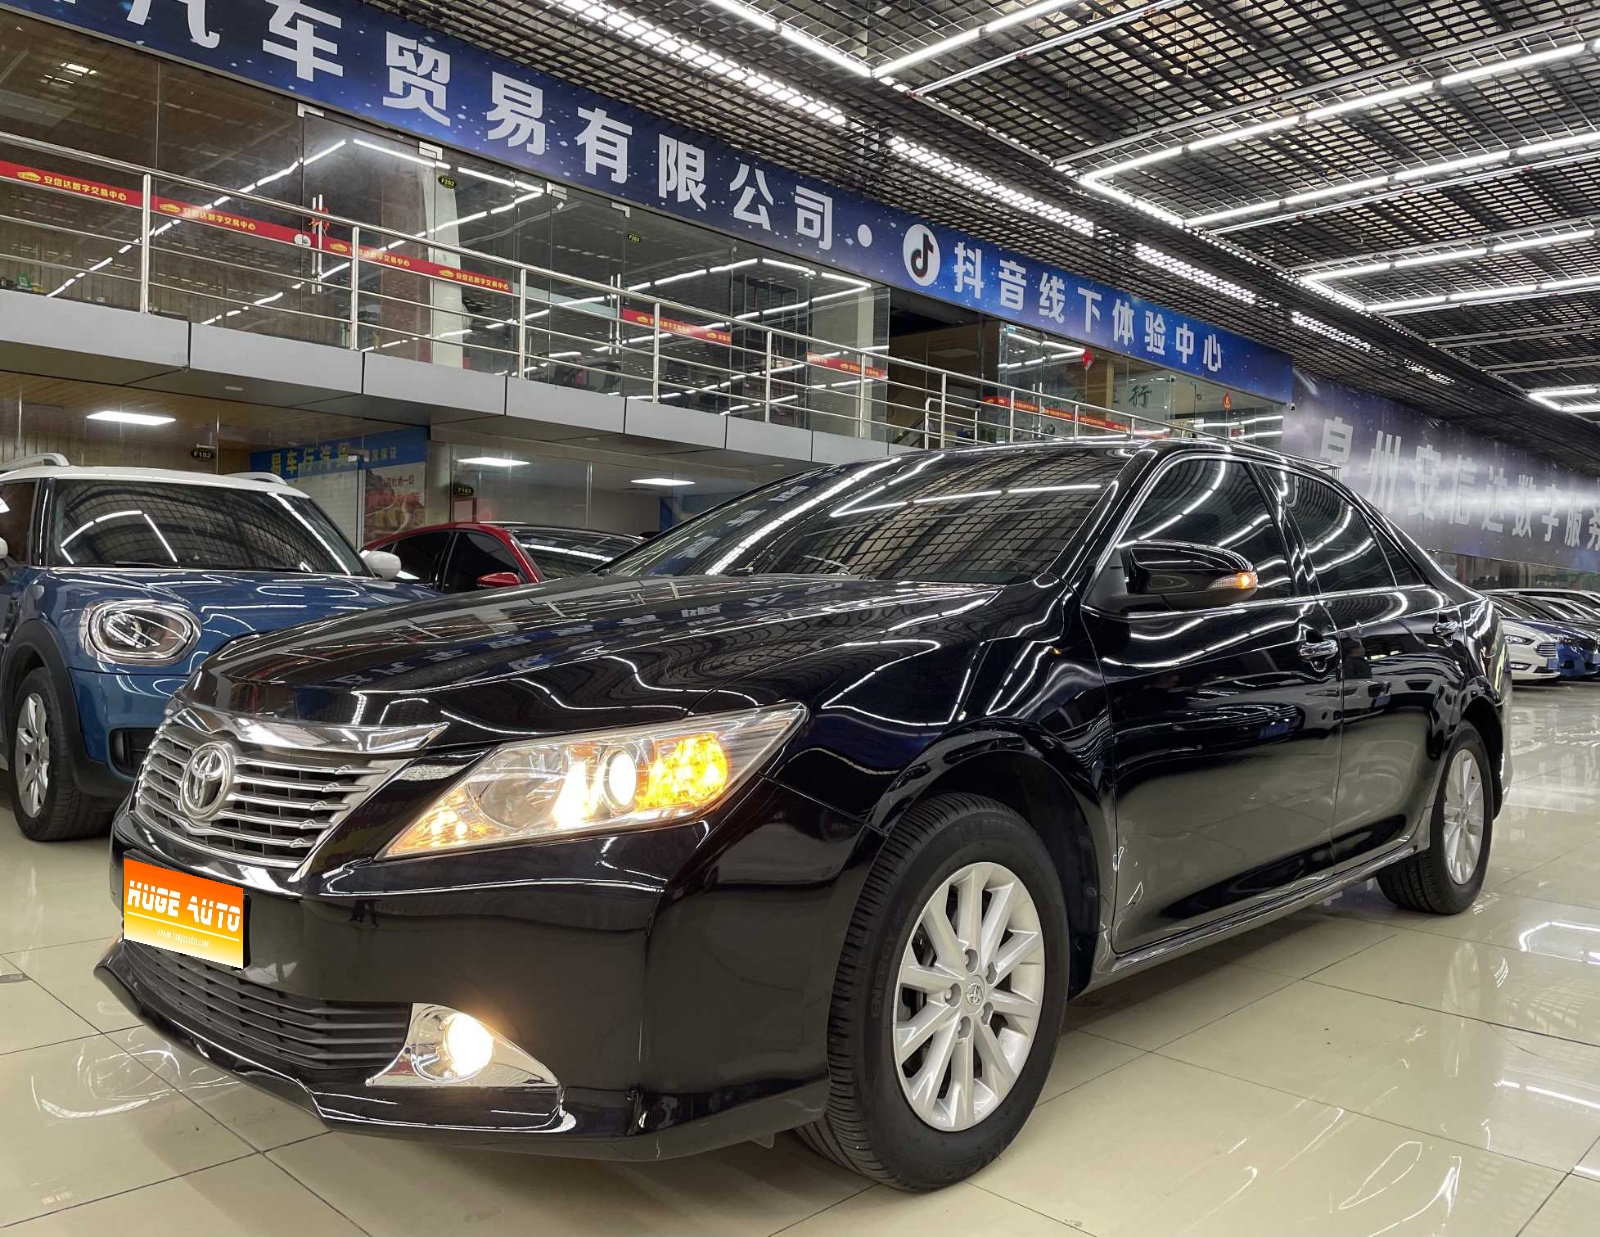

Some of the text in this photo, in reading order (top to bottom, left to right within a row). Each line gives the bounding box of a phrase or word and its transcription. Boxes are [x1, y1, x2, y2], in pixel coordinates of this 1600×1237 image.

[44, 175, 127, 201] 安信达数字交易中心
[953, 241, 1223, 373] 抖音线下体验中心
